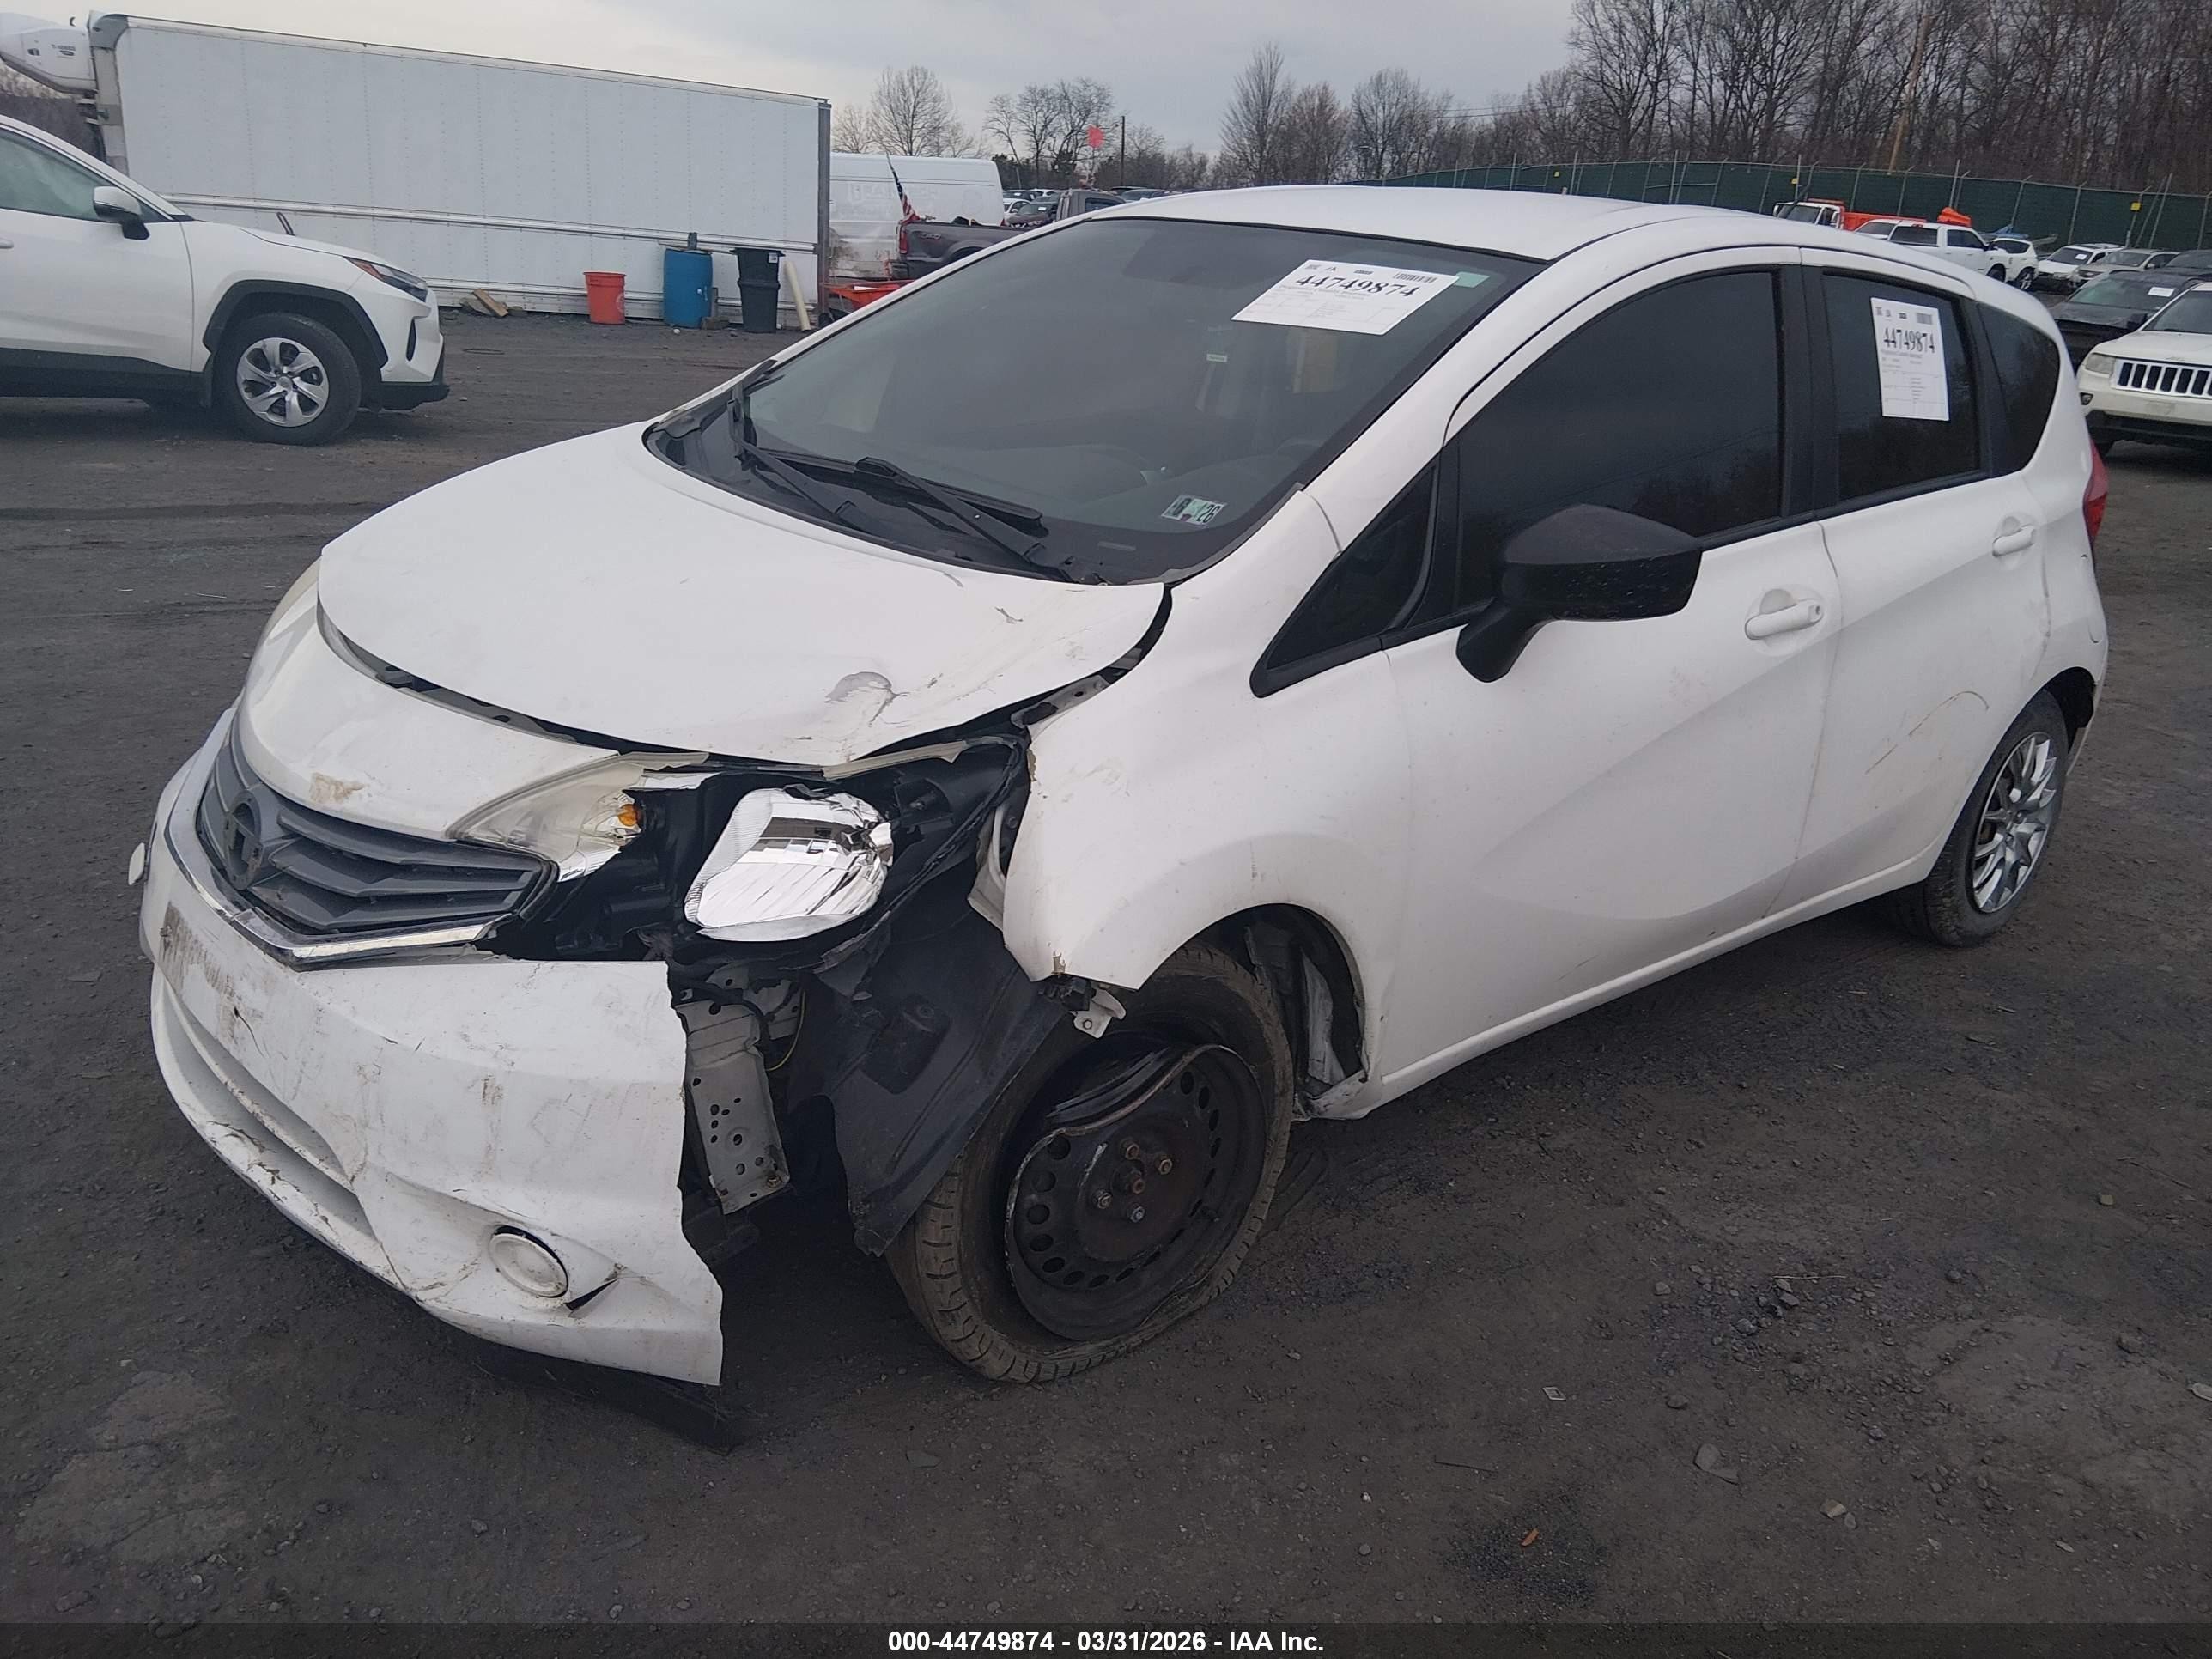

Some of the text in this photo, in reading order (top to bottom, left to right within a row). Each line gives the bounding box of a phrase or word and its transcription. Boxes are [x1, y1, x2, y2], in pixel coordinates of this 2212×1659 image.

[1296, 275, 1419, 296] 44749874
[1884, 327, 1935, 353] 44749874
[1196, 504, 1220, 523] 26
